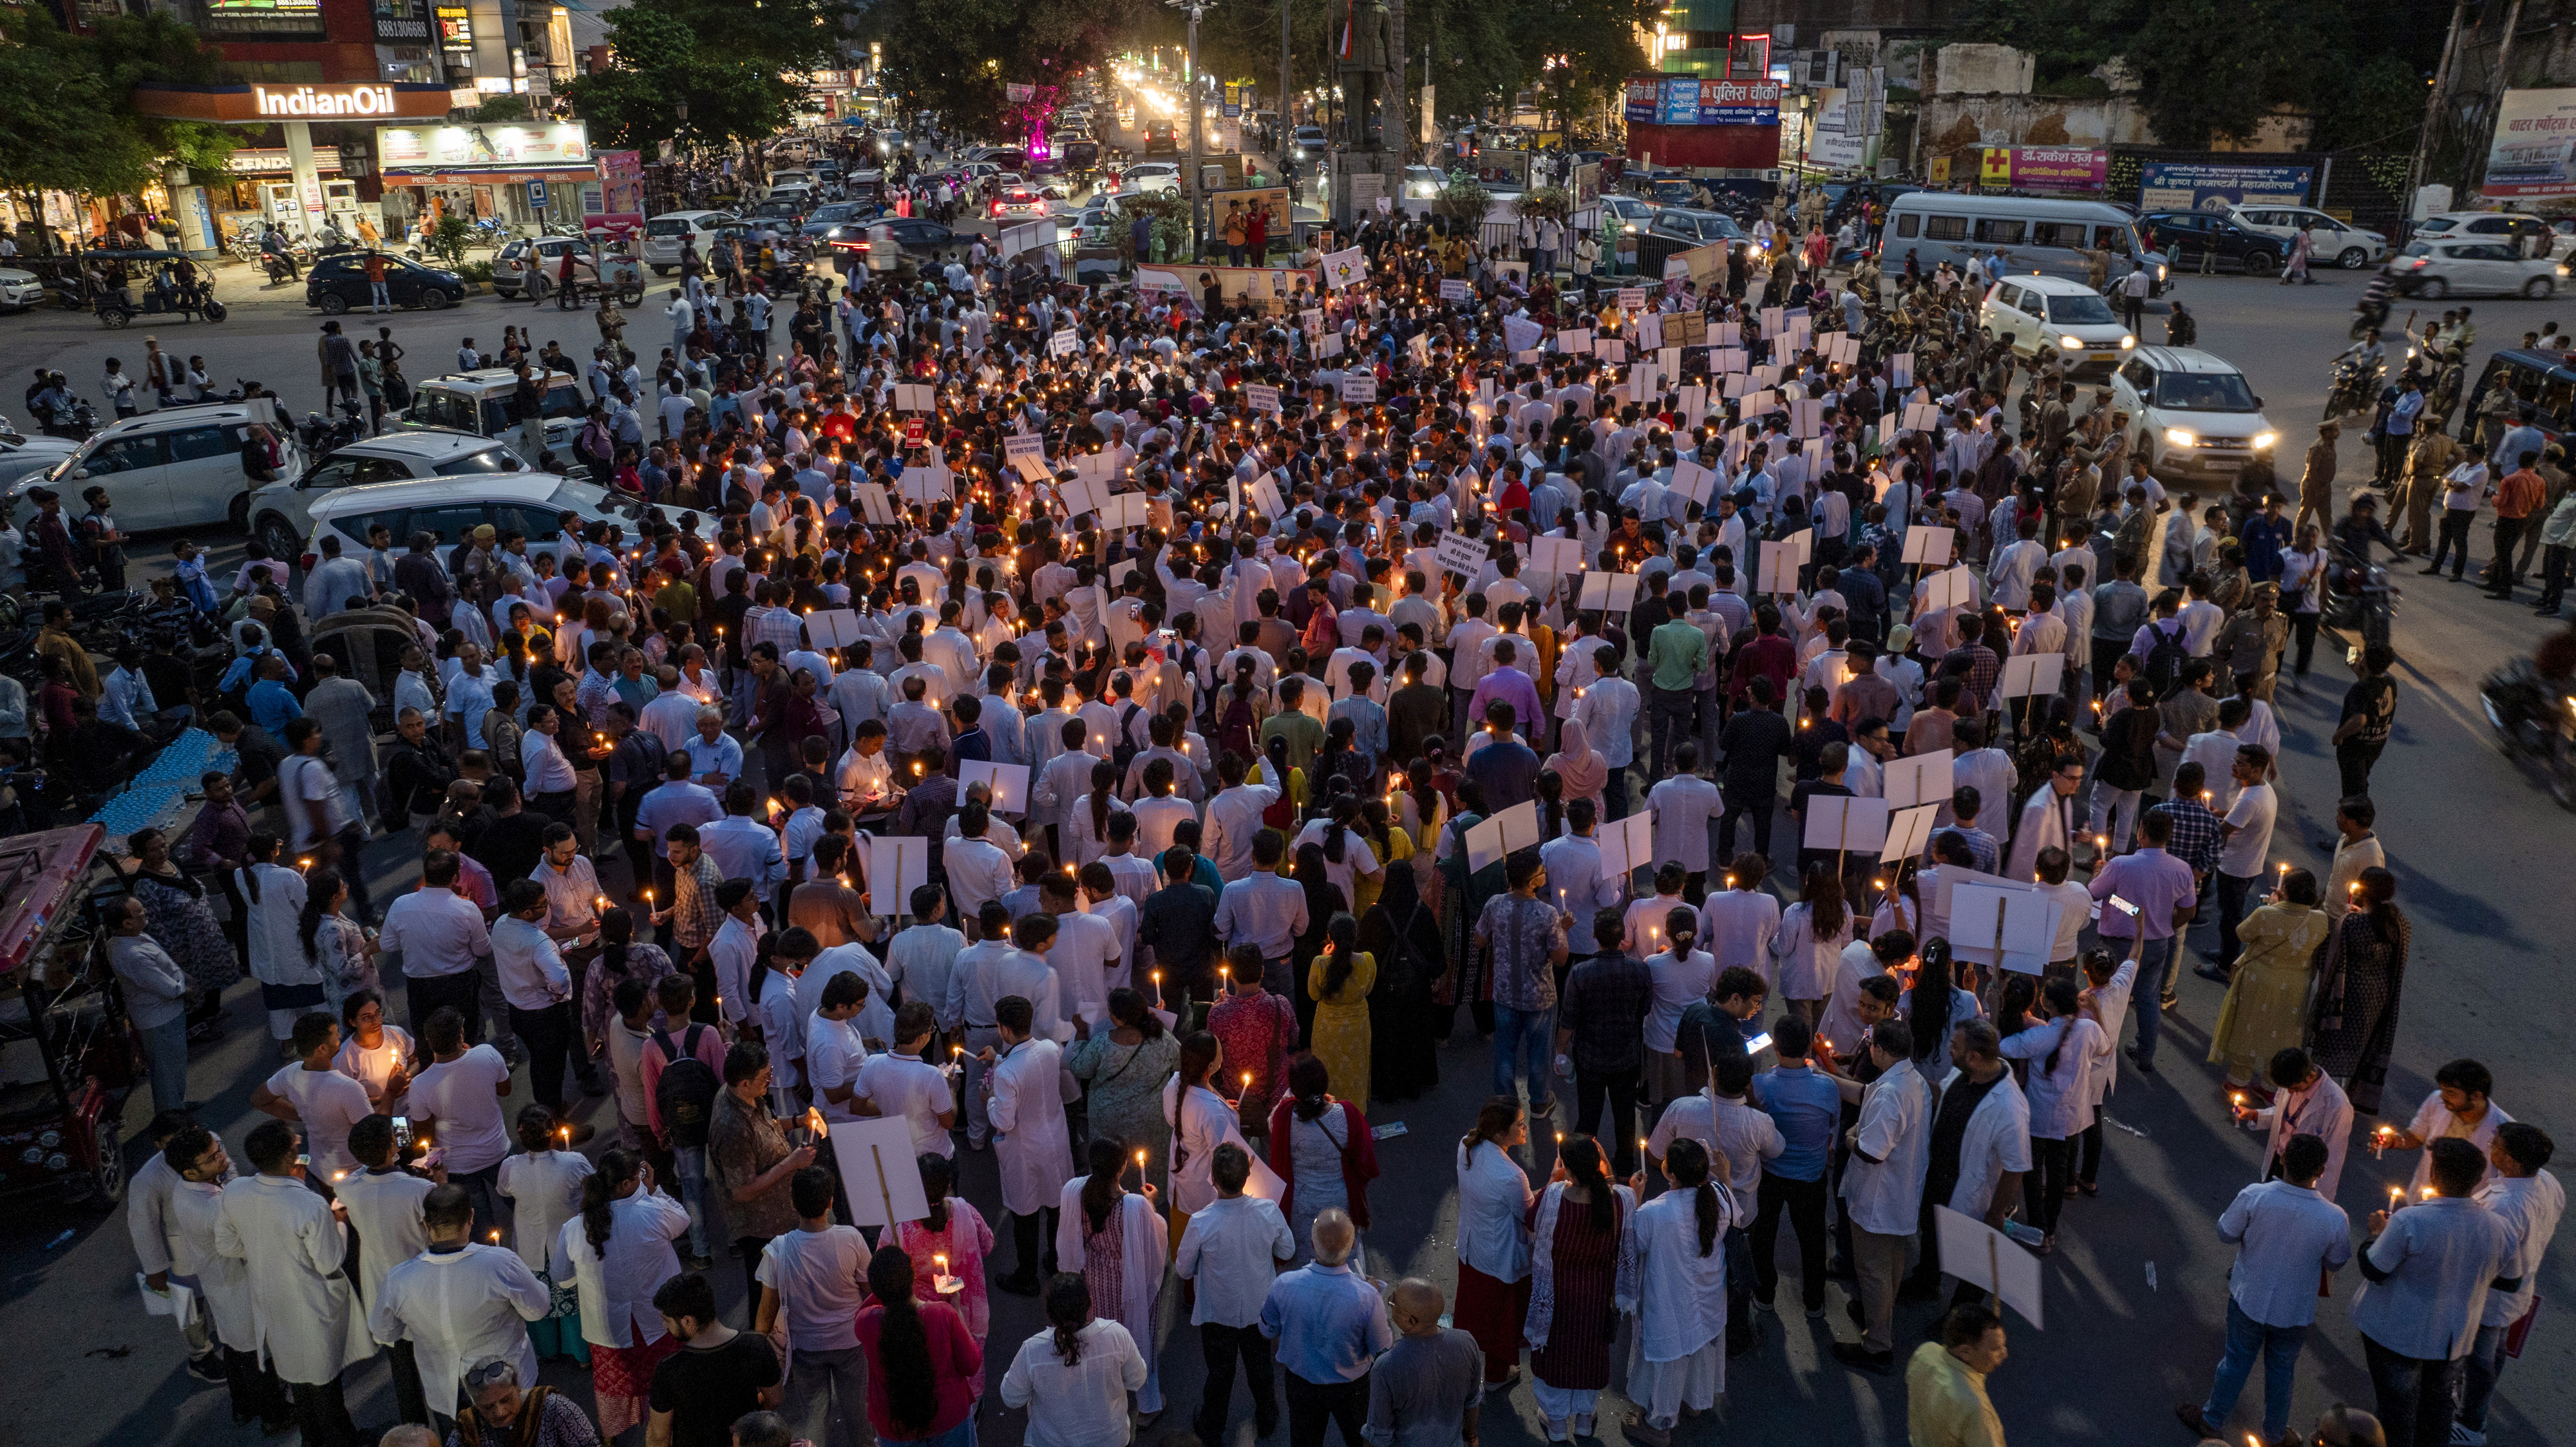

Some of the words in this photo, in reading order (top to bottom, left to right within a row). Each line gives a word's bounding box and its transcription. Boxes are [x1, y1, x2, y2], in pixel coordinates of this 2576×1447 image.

[377, 20, 427, 37] 8881306688
[1713, 82, 1747, 104] पुलिस
[1750, 82, 1779, 100] चौकी
[257, 87, 395, 115] IndianOil
[2509, 118, 2533, 131] वाटर
[2071, 153, 2093, 163] राज
[2154, 175, 2166, 186] श्री
[2168, 178, 2192, 188] कृष्ण
[2193, 178, 2239, 188] जन्माष्टमी
[2240, 178, 2295, 189] महामहोत्सव
[1437, 554, 1447, 563] बिना
[1446, 558, 1458, 567] सुरक्षा
[1470, 566, 1478, 574] सेवा
[1461, 553, 1472, 561] सुरक्षा
